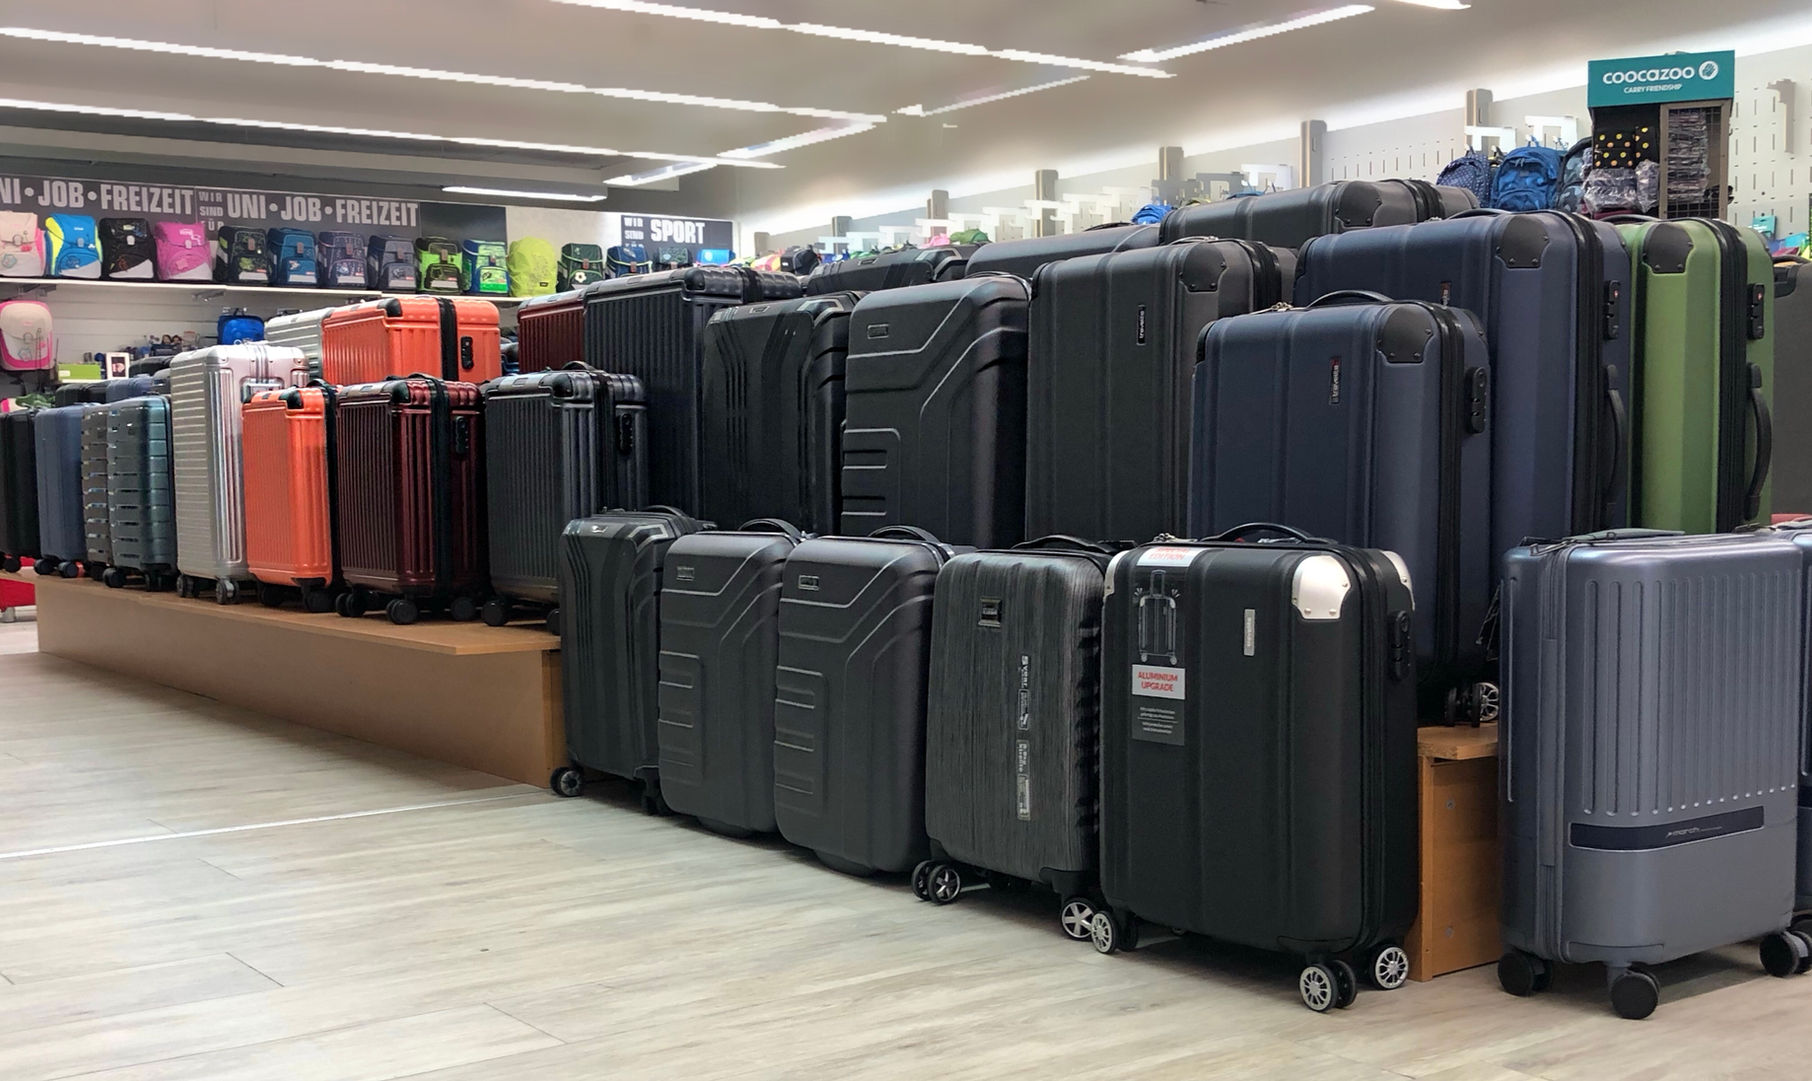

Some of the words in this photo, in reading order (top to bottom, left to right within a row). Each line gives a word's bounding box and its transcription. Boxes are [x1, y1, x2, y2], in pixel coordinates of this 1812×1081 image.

[1623, 86, 1646, 94] CARRY
[1646, 83, 1683, 92] FRIENDSHIP
[38, 180, 84, 208] JOB
[101, 184, 194, 214] FREIZEIT
[199, 191, 222, 202] WIR
[200, 206, 223, 217] SIND
[227, 193, 266, 219] UNI
[281, 196, 322, 221] JOB
[336, 199, 418, 227] FREIZEIT
[201, 218, 224, 231] ÜR
[624, 217, 643, 227] WIR
[650, 219, 705, 244] SPORT
[1138, 671, 1178, 682] ALUMINIUM
[1141, 681, 1174, 692] UPGRADE
